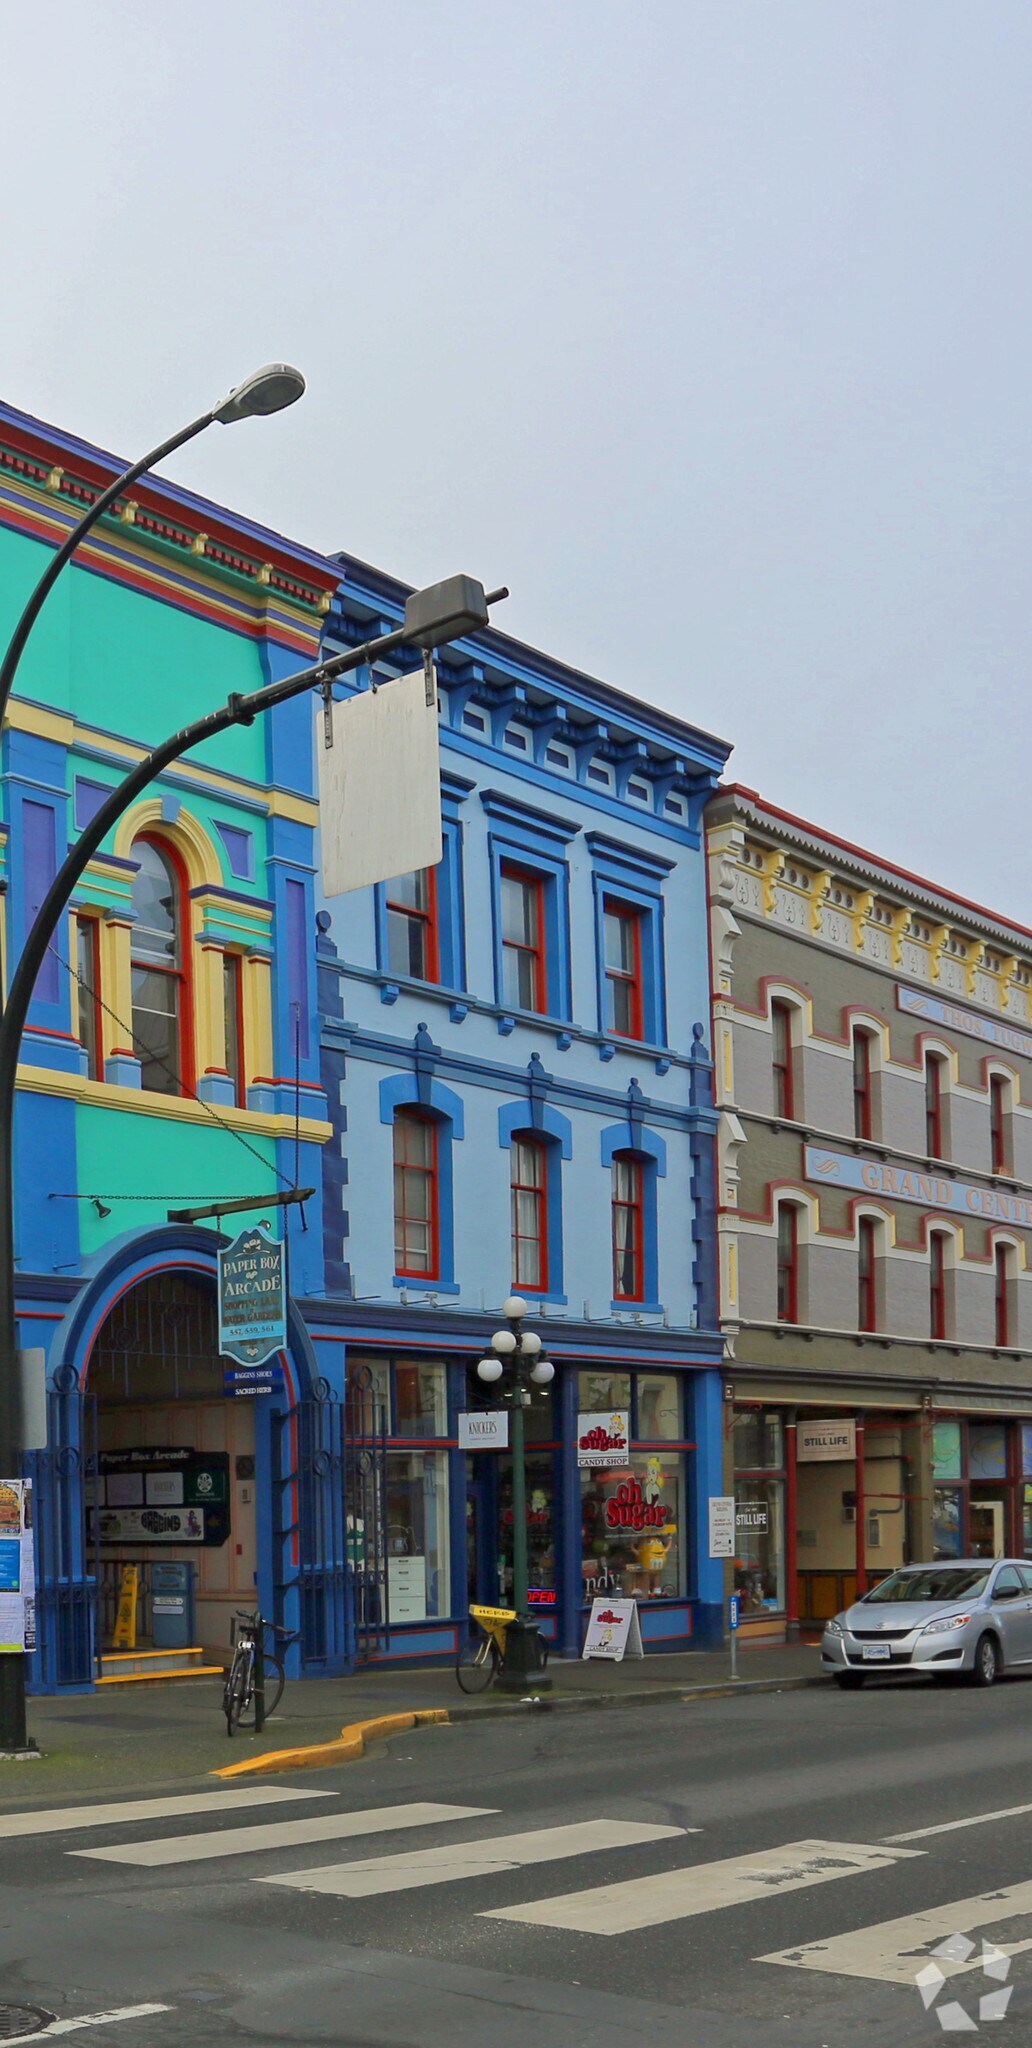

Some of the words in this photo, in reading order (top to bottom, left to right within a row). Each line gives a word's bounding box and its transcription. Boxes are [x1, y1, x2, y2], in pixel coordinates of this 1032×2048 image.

[861, 1163, 954, 1204] GRAND
[223, 1258, 258, 1277] PAPER
[260, 1255, 280, 1270] BOX
[225, 1274, 281, 1296] ARCADE
[234, 1371, 255, 1379] BAGGINS
[256, 1370, 273, 1378] SHOES
[235, 1387, 256, 1395] SACRED
[257, 1386, 272, 1394] HERB
[468, 1421, 497, 1435] KNICKERS
[587, 1426, 607, 1439] oh
[804, 1437, 828, 1447] STILL
[829, 1436, 848, 1446] LIFE
[101, 1452, 129, 1463] Paper
[131, 1451, 151, 1460] Box
[152, 1449, 191, 1460] Arcade
[616, 1476, 642, 1504] oh
[141, 1510, 181, 1534] BAGGINS
[736, 1514, 752, 1526] STILL
[753, 1513, 767, 1525] LIFE
